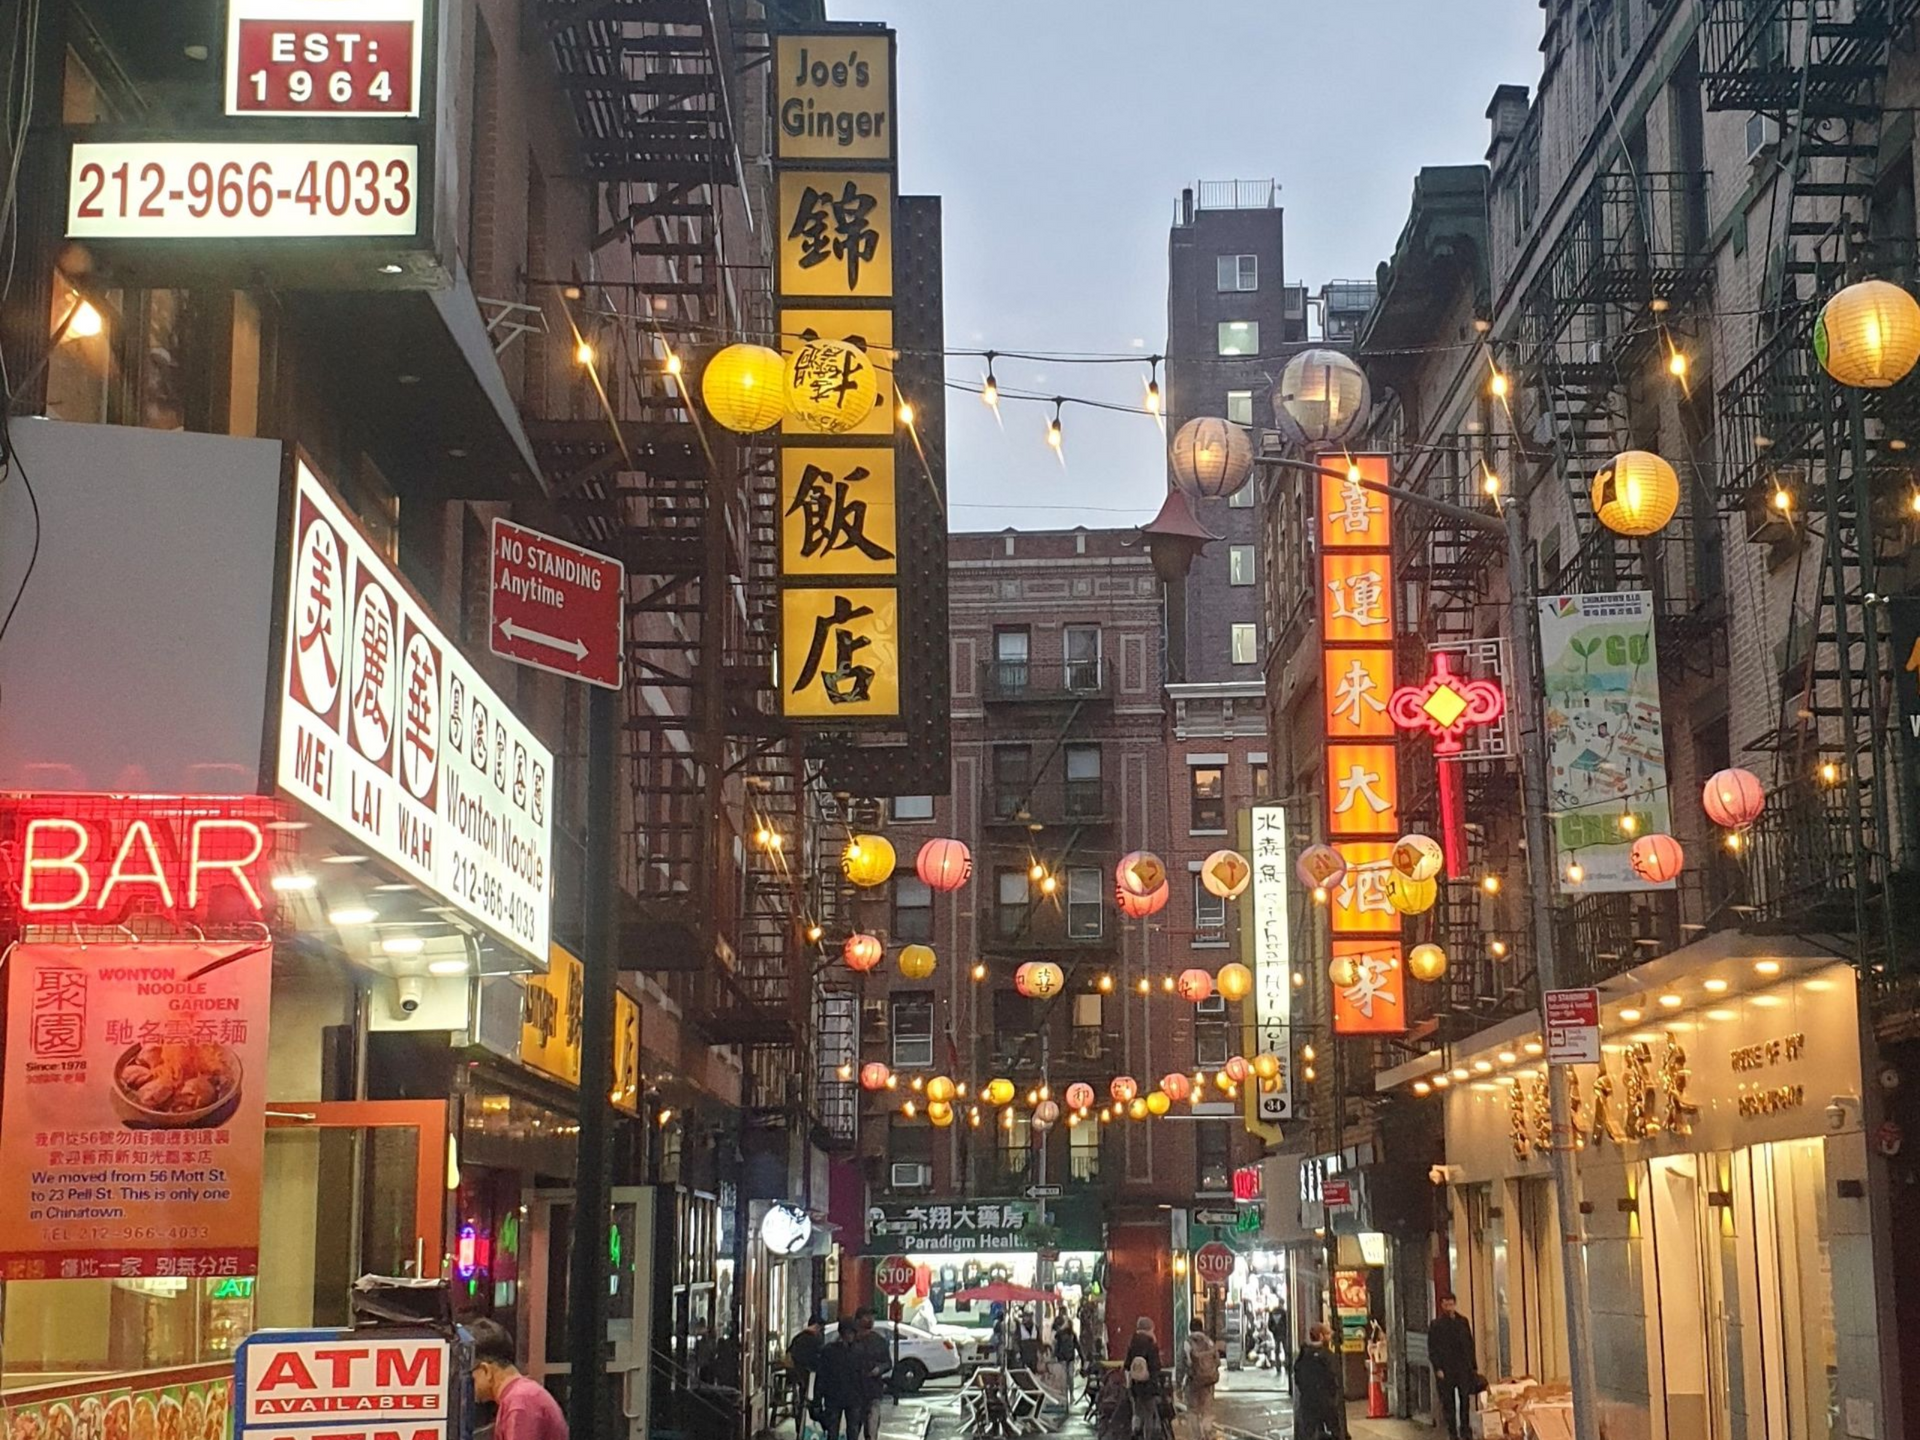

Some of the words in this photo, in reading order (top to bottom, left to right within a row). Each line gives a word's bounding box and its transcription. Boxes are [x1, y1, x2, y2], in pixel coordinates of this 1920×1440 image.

[271, 33, 379, 63] EST:
[796, 50, 870, 87] Joe's
[781, 97, 886, 145] Ginger
[77, 160, 411, 218] 212-966-4033
[501, 536, 523, 564] NO
[528, 547, 601, 591] STANDING
[501, 568, 564, 608] Anytime
[295, 724, 333, 801] MEI
[351, 770, 381, 836] LAI
[399, 802, 433, 871] WAH
[447, 764, 497, 858] Wonton
[502, 813, 543, 892] Noodle
[22, 818, 263, 911] BAR
[453, 850, 535, 943] 212-966-4033
[99, 968, 175, 981] WONTON
[137, 983, 207, 996] NOODLE
[169, 998, 239, 1011] GARDEN
[1267, 1100, 1282, 1111] 34
[32, 1172, 55, 1184] We
[58, 1171, 107, 1183] moved
[111, 1170, 146, 1183] from
[150, 1171, 167, 1183] 56
[171, 1170, 204, 1182] Mott
[208, 1169, 227, 1182] St.
[31, 1190, 45, 1202] to
[48, 1189, 64, 1201] 23
[68, 1188, 92, 1200] Pell
[120, 1187, 150, 1200] This
[154, 1188, 166, 1200] is
[170, 1187, 199, 1203] only
[203, 1190, 230, 1200] one
[30, 1208, 42, 1220] in
[46, 1206, 126, 1220] Chinatown.
[79, 1227, 209, 1240] 212-966-4033
[905, 1234, 976, 1251] Paradigm
[1199, 1255, 1232, 1270] STOP
[879, 1269, 914, 1283] STOP
[256, 1348, 442, 1392] ATM
[259, 1396, 437, 1413] AVAILABLE
